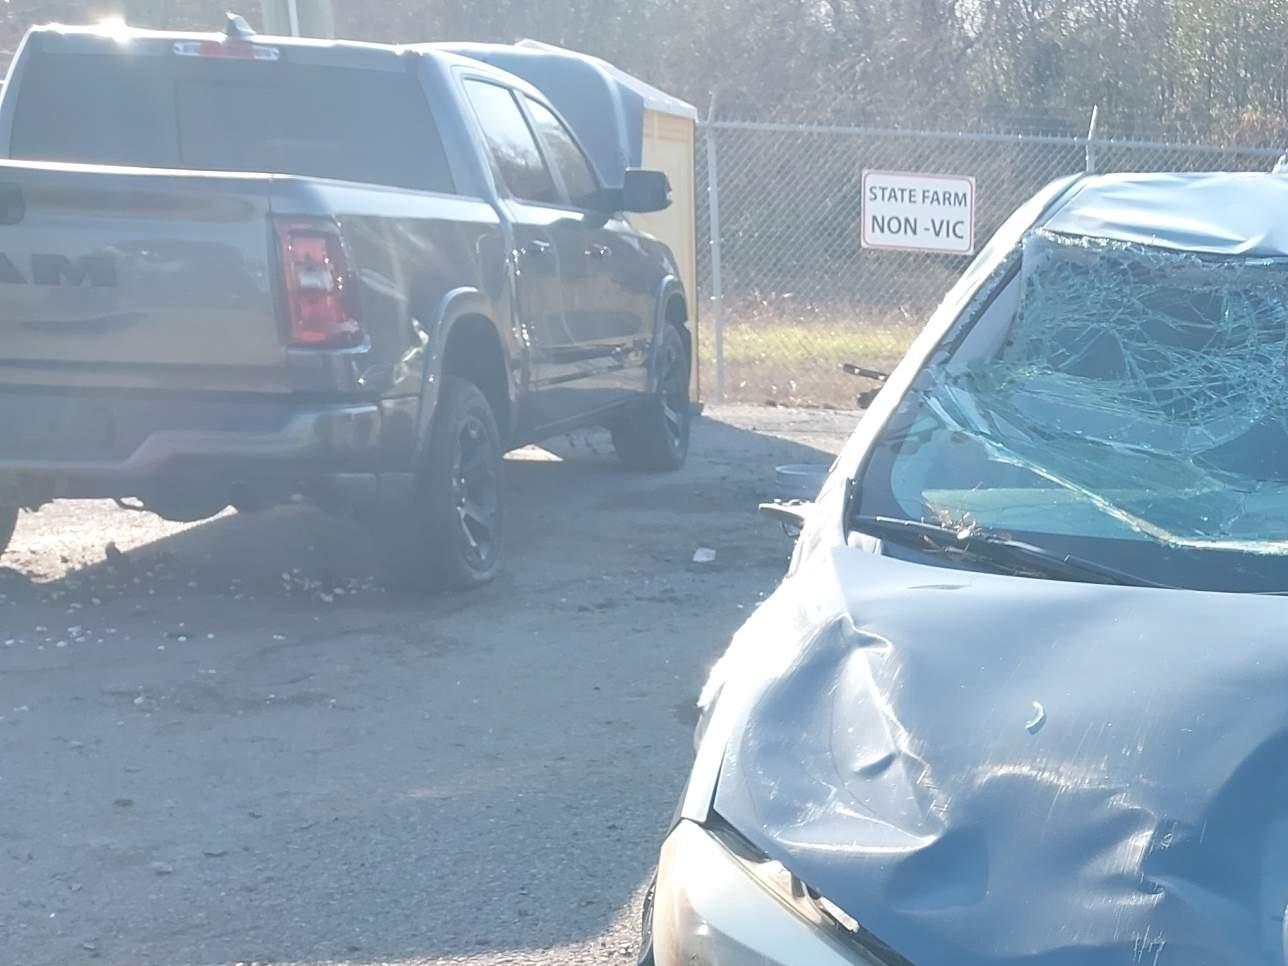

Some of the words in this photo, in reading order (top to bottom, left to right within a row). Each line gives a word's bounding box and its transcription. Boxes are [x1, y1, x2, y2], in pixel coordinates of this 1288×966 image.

[869, 186, 917, 204] STATE
[922, 189, 968, 208] FARM
[871, 215, 918, 236] NON
